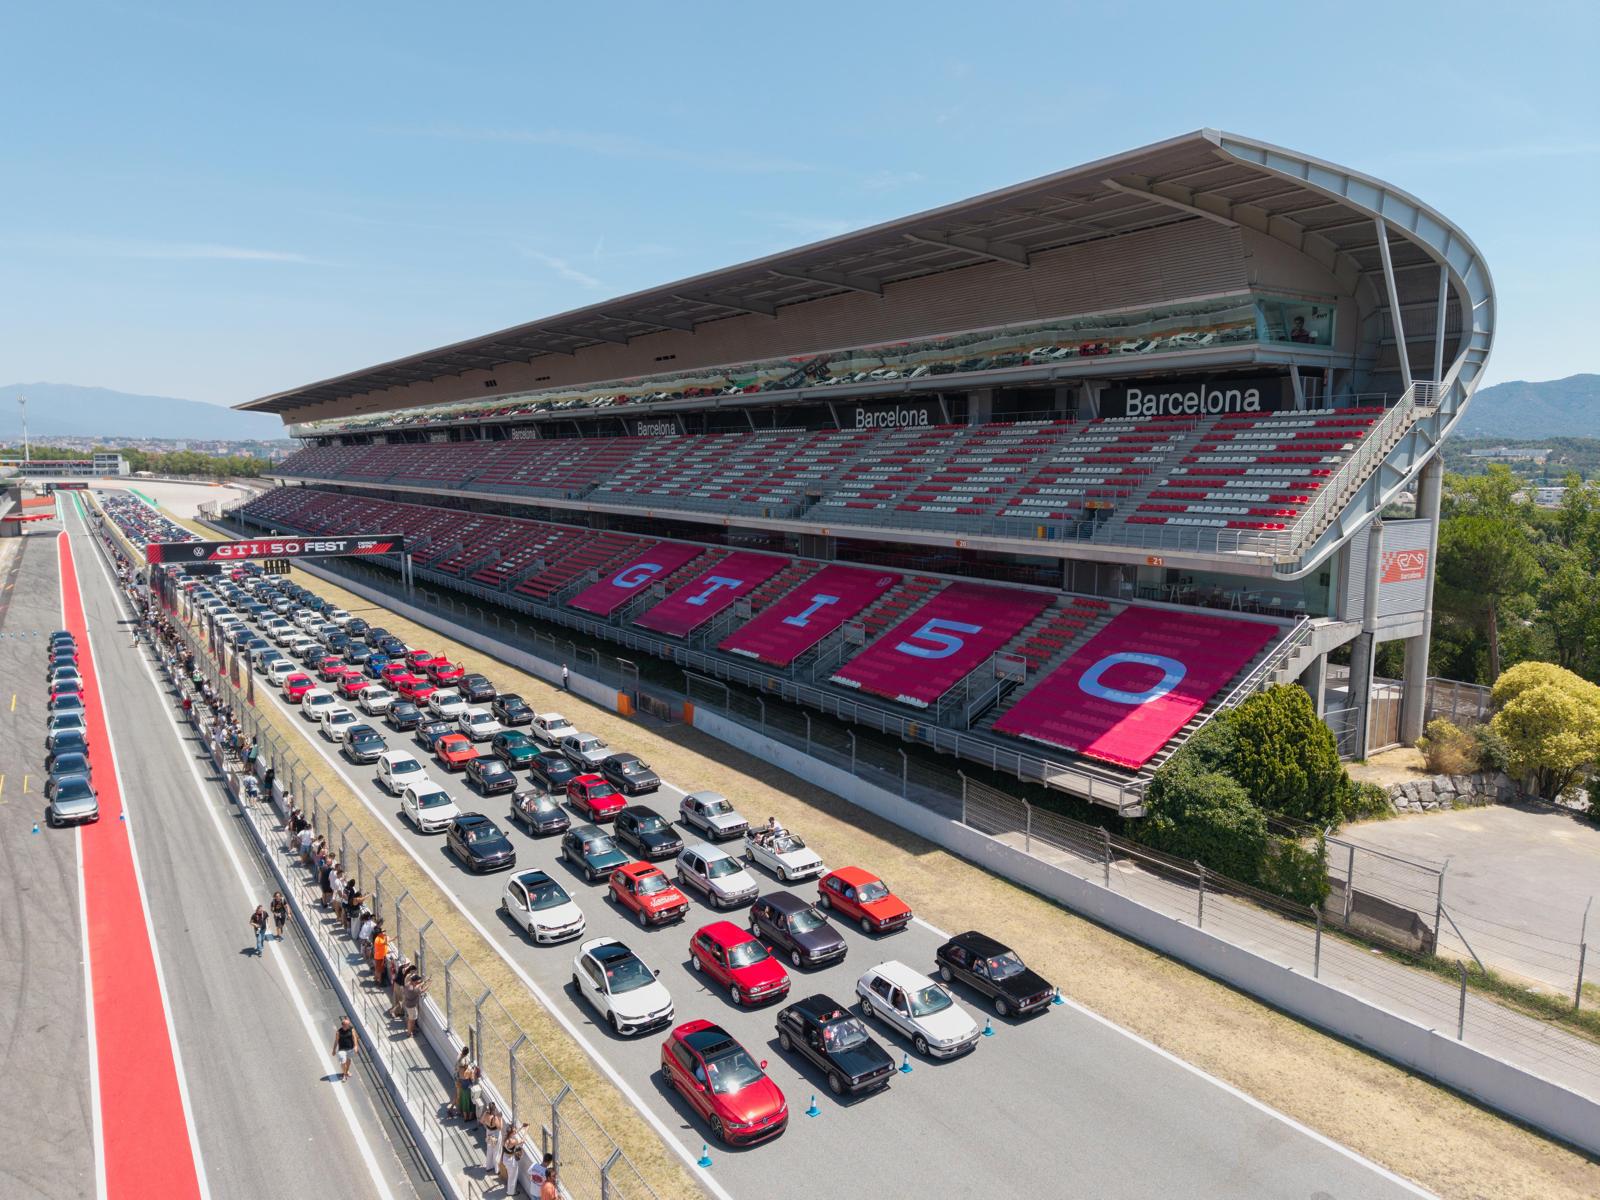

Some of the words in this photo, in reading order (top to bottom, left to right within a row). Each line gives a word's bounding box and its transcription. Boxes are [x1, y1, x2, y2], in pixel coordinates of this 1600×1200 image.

[1125, 384, 1261, 416] Barcelona
[855, 405, 929, 428] Barcelona
[637, 419, 676, 436] Barcelona
[216, 544, 259, 556] GTI
[270, 542, 300, 554] 50
[304, 541, 348, 552] FEST
[1152, 557, 1163, 565] 21
[611, 562, 664, 589] G
[685, 575, 745, 606] T
[782, 593, 841, 628] I
[894, 617, 984, 659] 5
